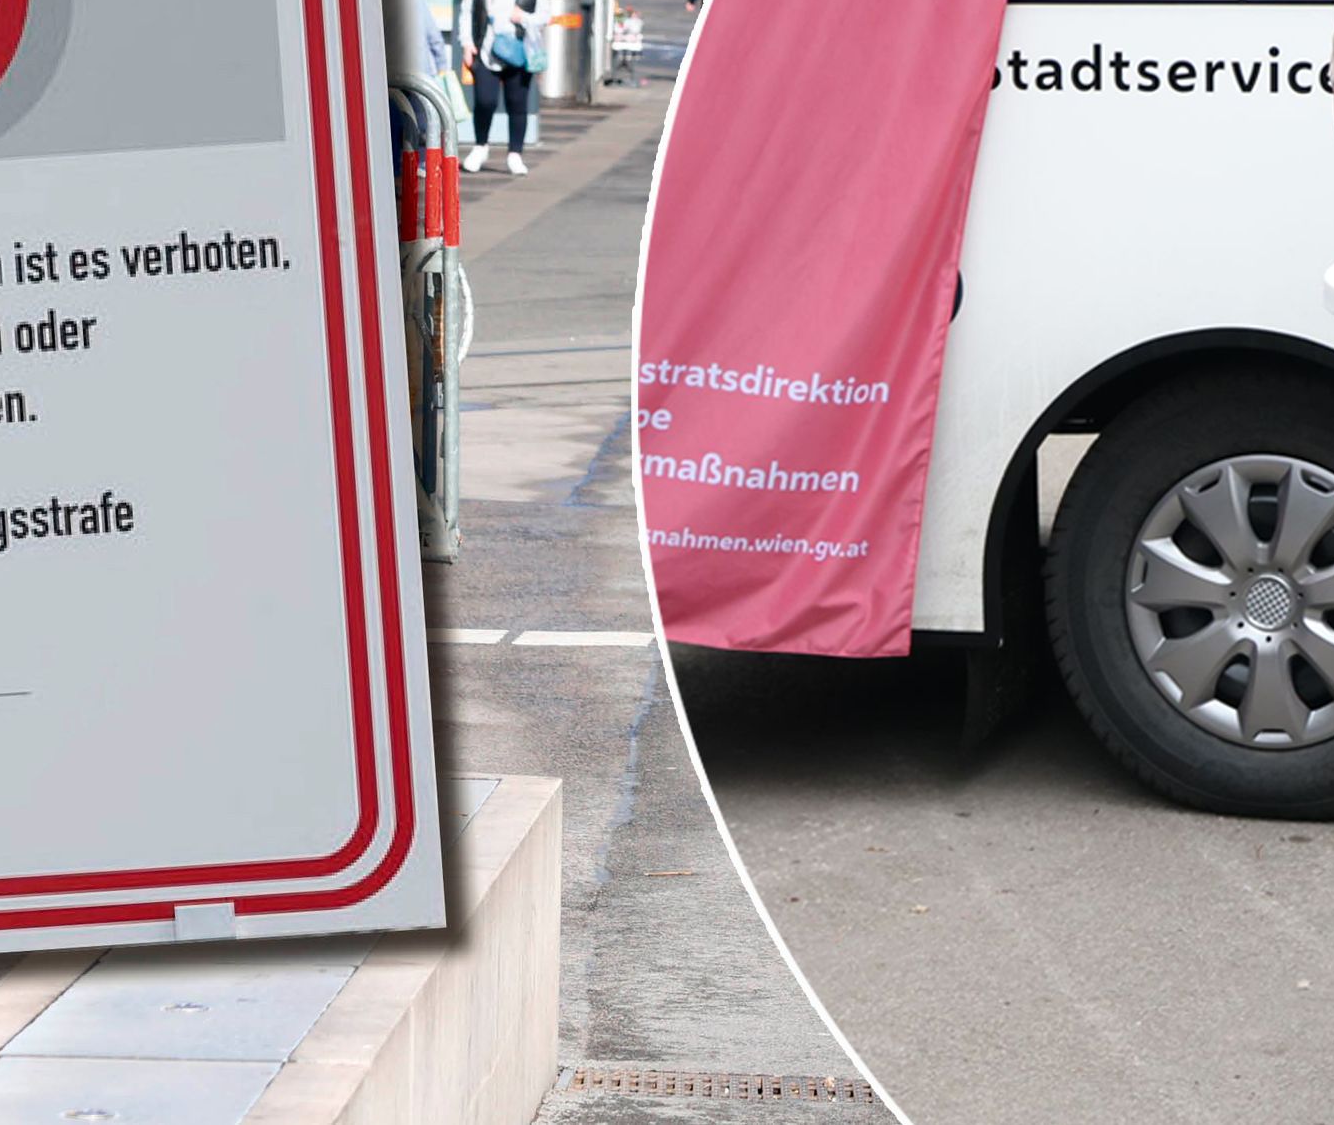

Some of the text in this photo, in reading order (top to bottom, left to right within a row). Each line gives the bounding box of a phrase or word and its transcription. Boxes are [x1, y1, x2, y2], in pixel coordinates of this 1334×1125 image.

[14, 242, 59, 284] ist
[69, 248, 110, 281] es
[120, 231, 289, 277] verboten.
[15, 309, 96, 353] oder
[641, 452, 860, 493] maßnahmen
